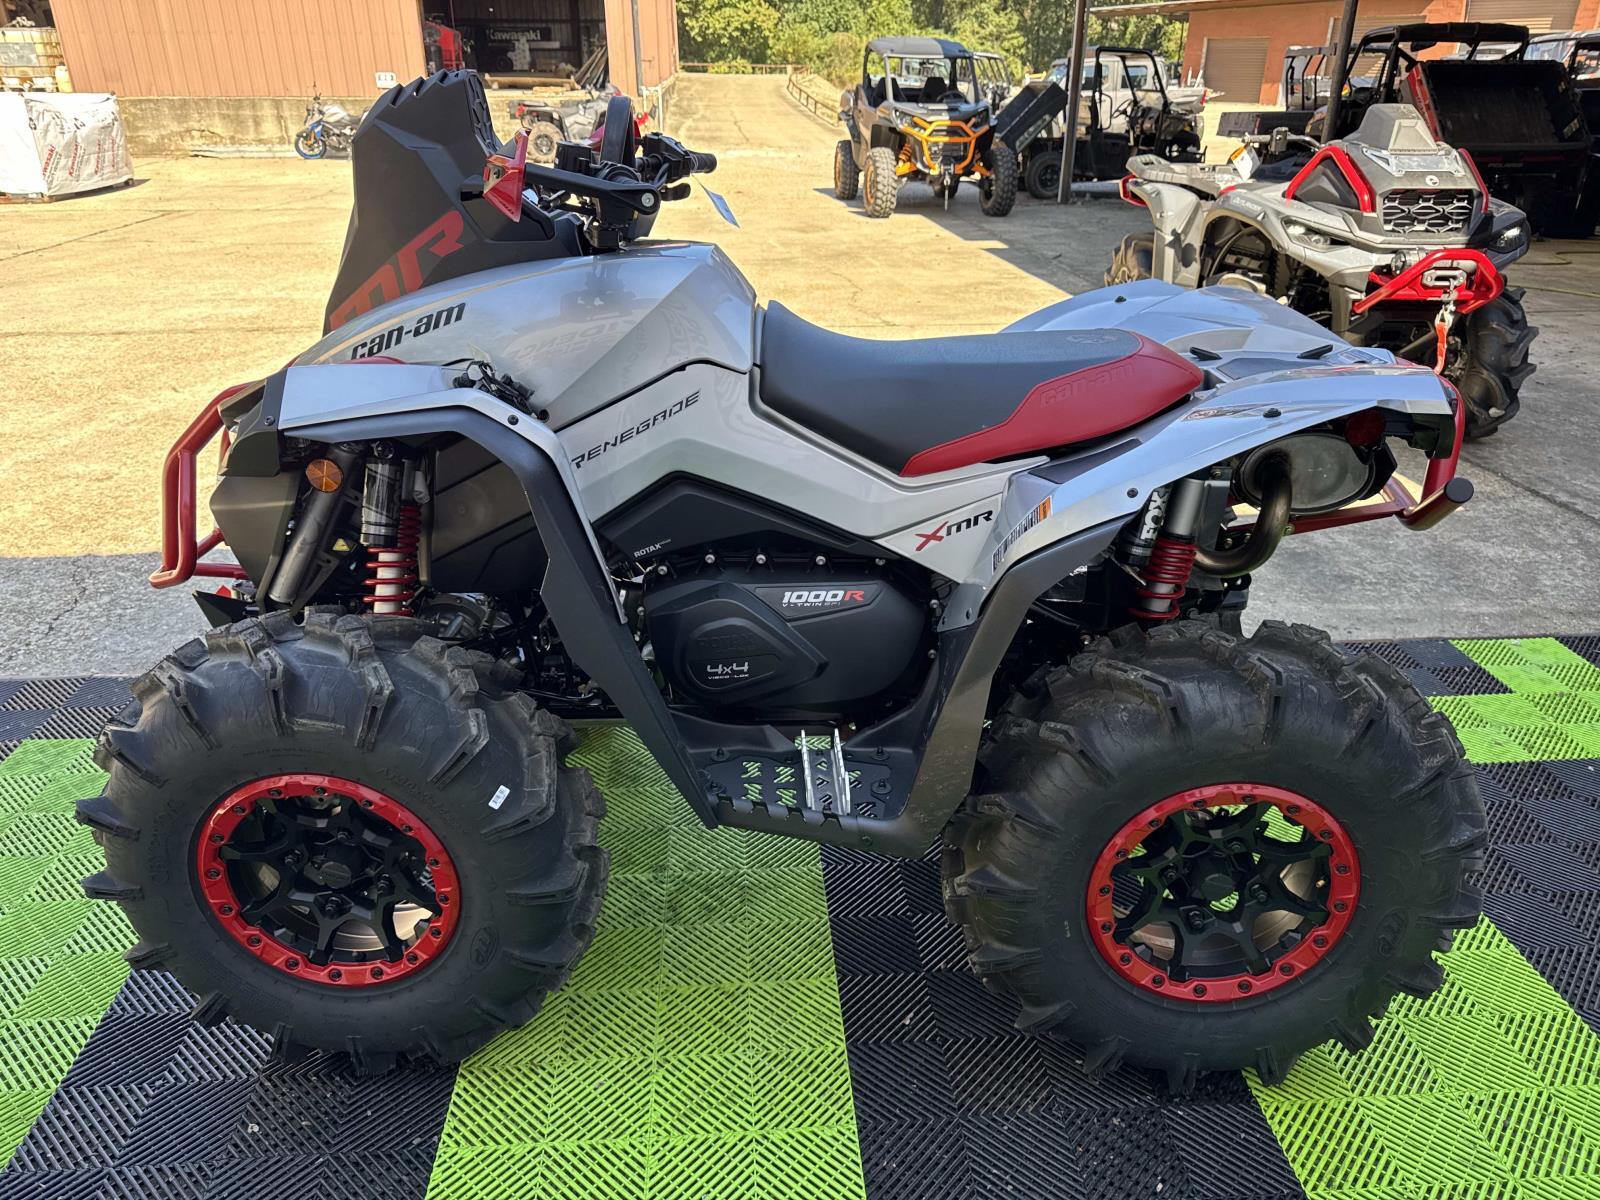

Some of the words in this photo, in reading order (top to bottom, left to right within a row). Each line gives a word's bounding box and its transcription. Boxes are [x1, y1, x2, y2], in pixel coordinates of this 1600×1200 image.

[486, 28, 541, 40] Kawasaki
[351, 303, 466, 360] can-am
[571, 389, 700, 469] RENEGADE
[634, 543, 662, 558] ROTAX
[782, 590, 865, 603] 1000R
[707, 661, 749, 674] 4x4
